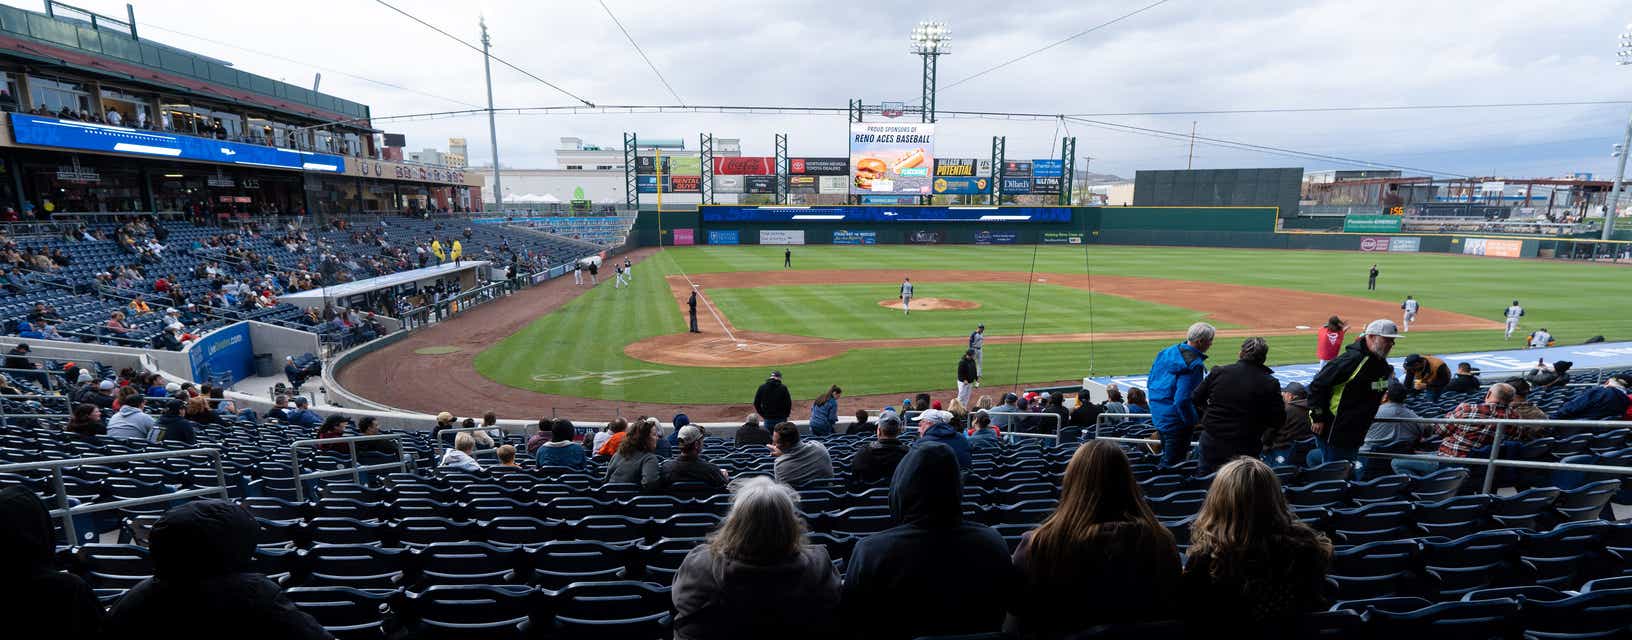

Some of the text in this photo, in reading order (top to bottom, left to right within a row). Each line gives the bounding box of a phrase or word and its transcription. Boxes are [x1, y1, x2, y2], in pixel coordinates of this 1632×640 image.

[855, 134, 930, 144] RENO ACES BASEBALL
[936, 165, 972, 175] POTENTIAL
[1004, 179, 1029, 188] Dillard's
